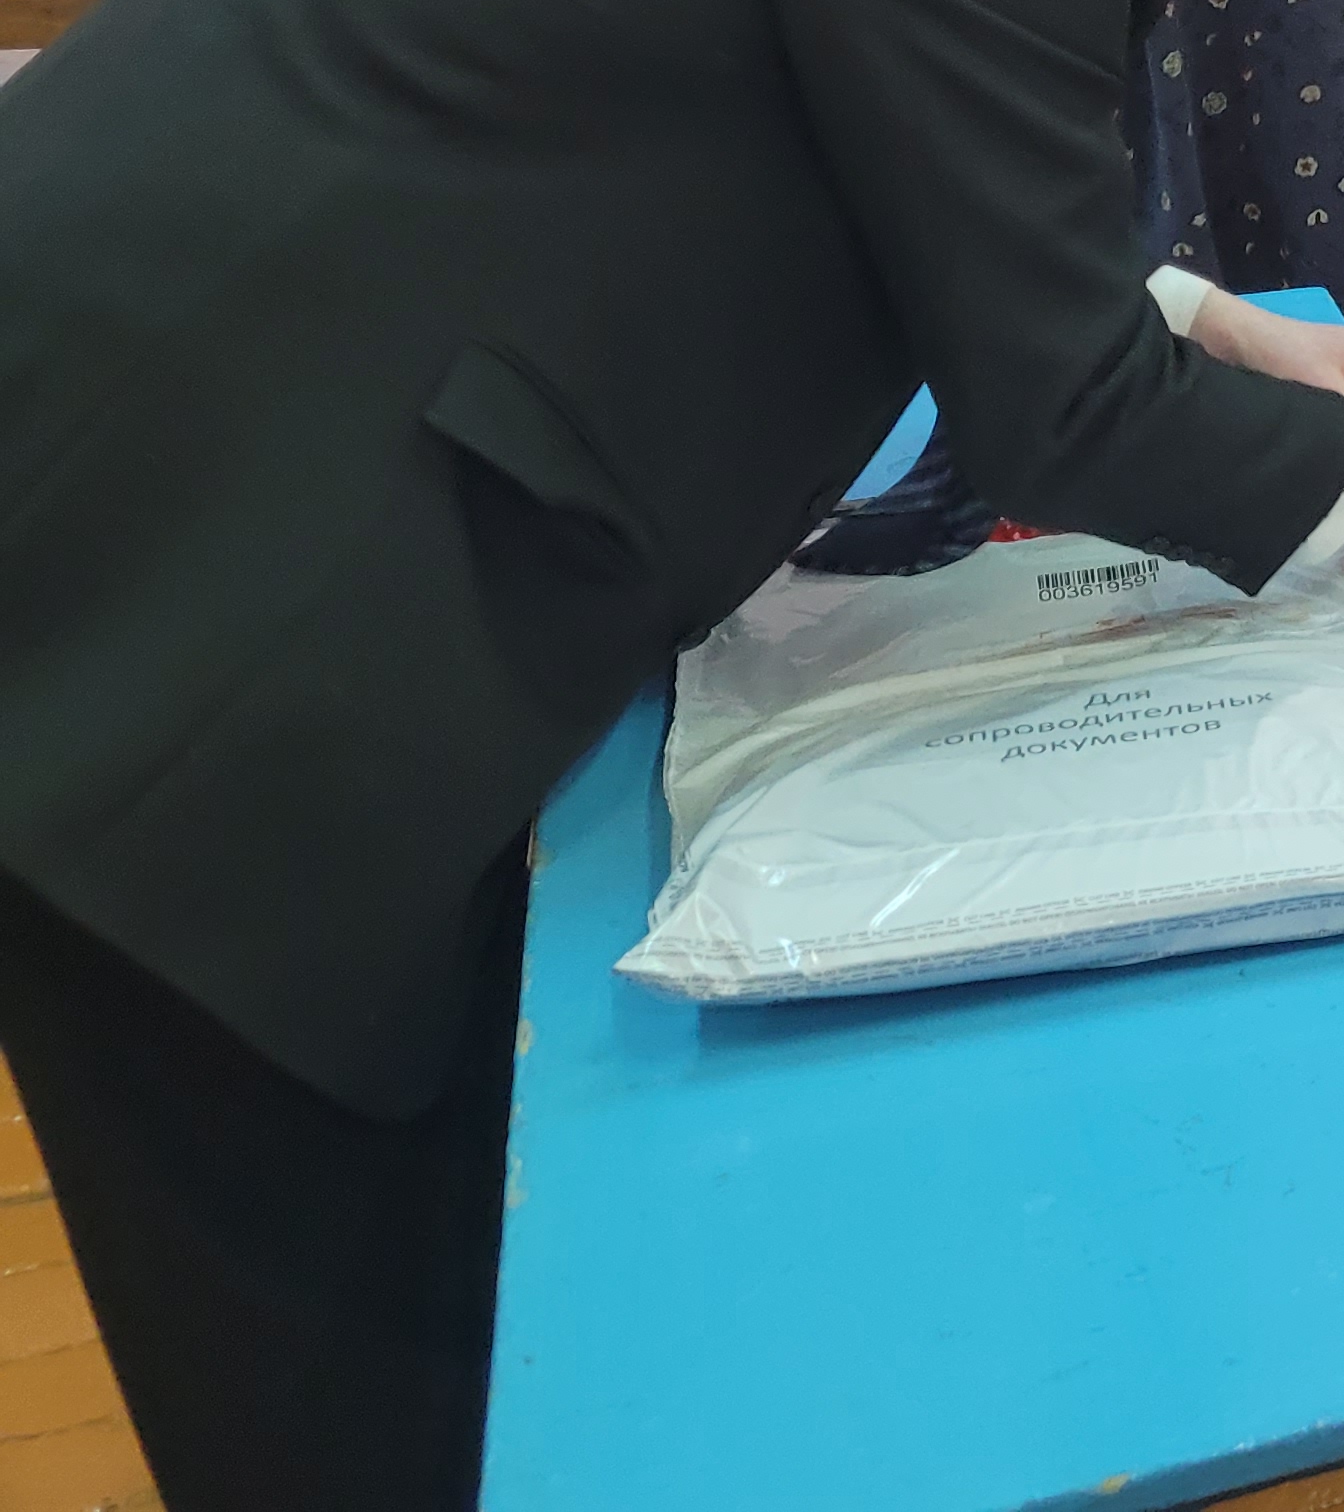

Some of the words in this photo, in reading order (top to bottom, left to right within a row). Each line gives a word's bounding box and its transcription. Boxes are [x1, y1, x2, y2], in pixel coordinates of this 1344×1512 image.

[1038, 572, 1158, 602] 003619591
[1084, 690, 1151, 711] Для
[925, 691, 1274, 748] сопроводительных
[1000, 719, 1222, 762] документов
